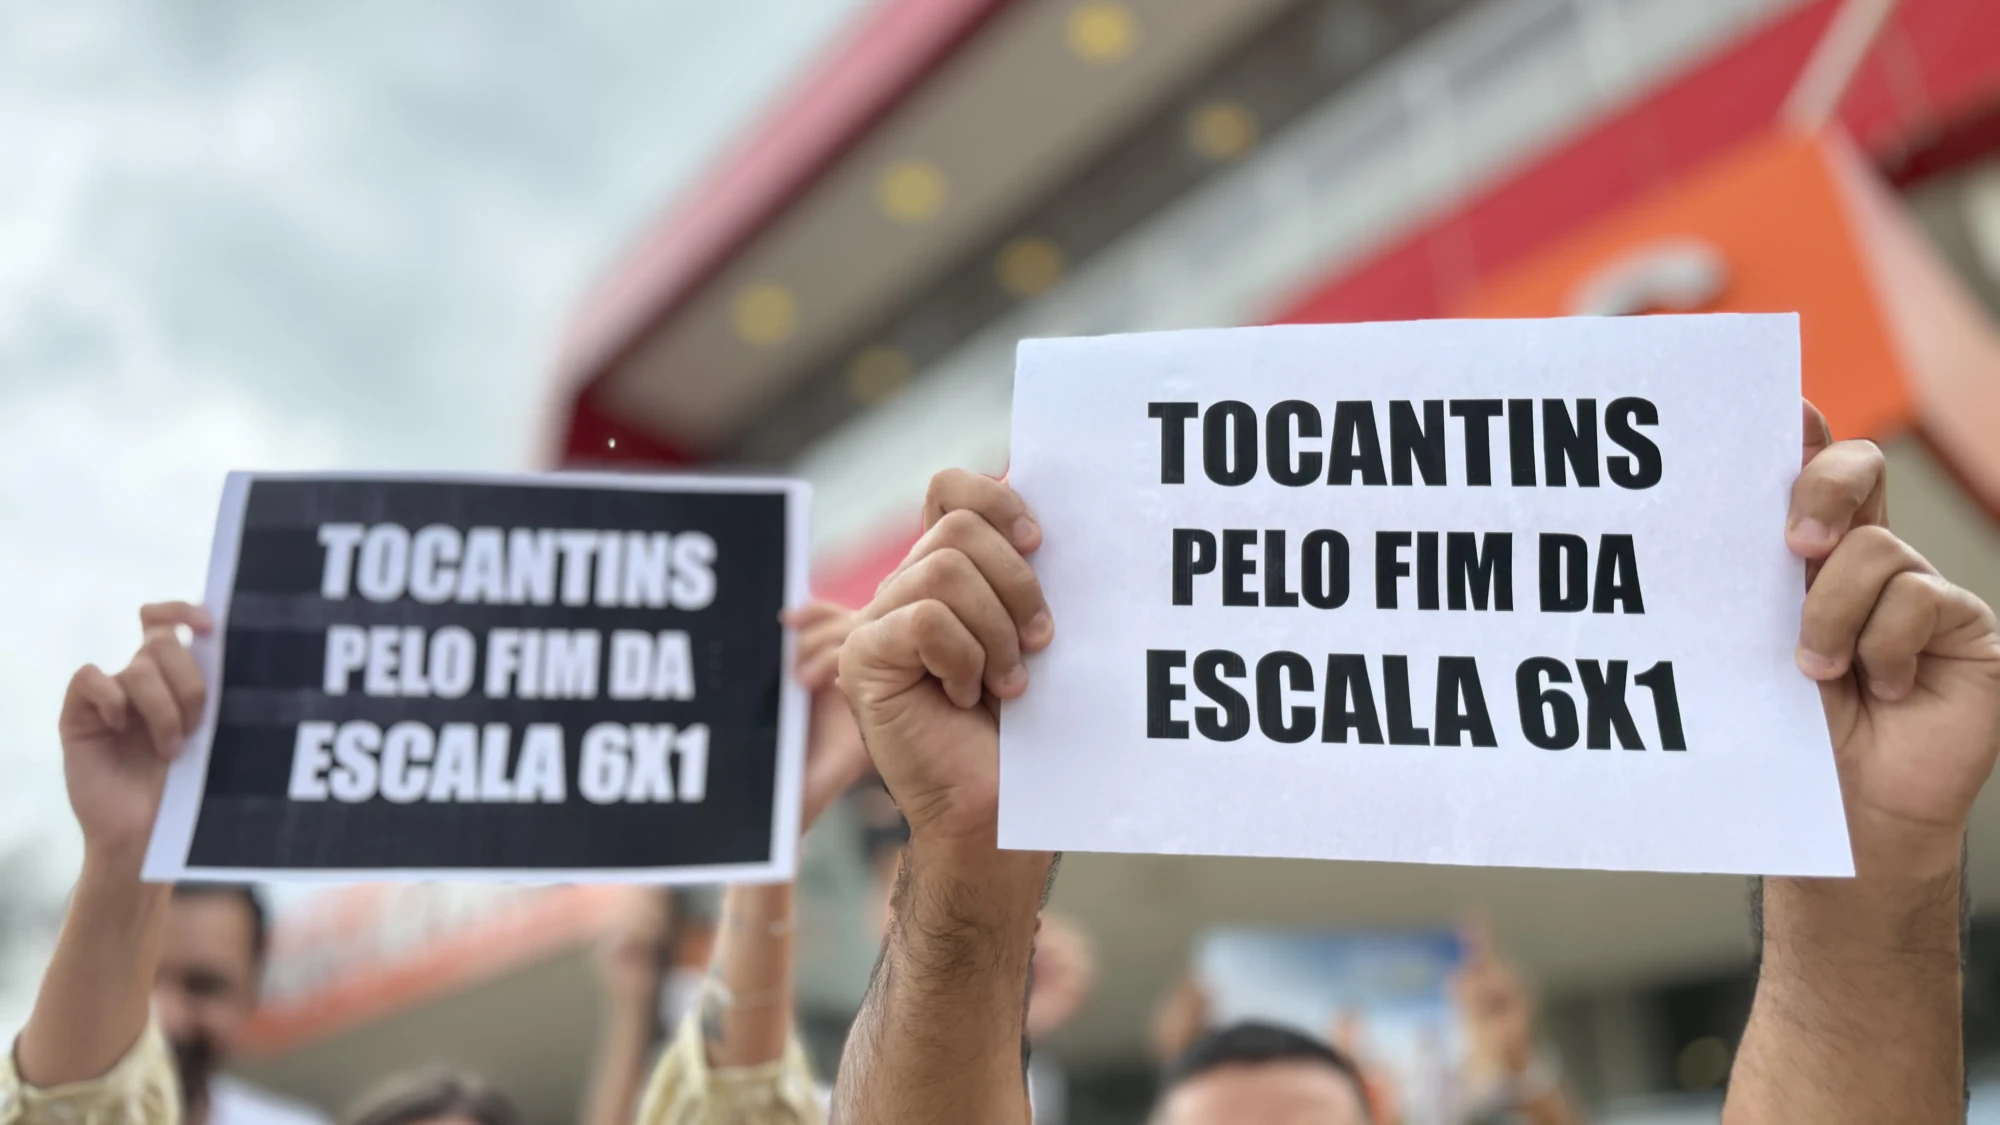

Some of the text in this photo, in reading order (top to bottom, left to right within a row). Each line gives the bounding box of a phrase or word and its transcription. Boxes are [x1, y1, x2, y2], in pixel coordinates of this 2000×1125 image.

[1148, 396, 1663, 490] TOCANTINS
[318, 523, 716, 610] TOCANTINS
[1172, 528, 1646, 615] PELO FIM DA
[323, 625, 696, 700] PELO FIM DA
[1146, 649, 1687, 752] ESCALA 6X1
[288, 720, 711, 804] ESCALA 6X1
